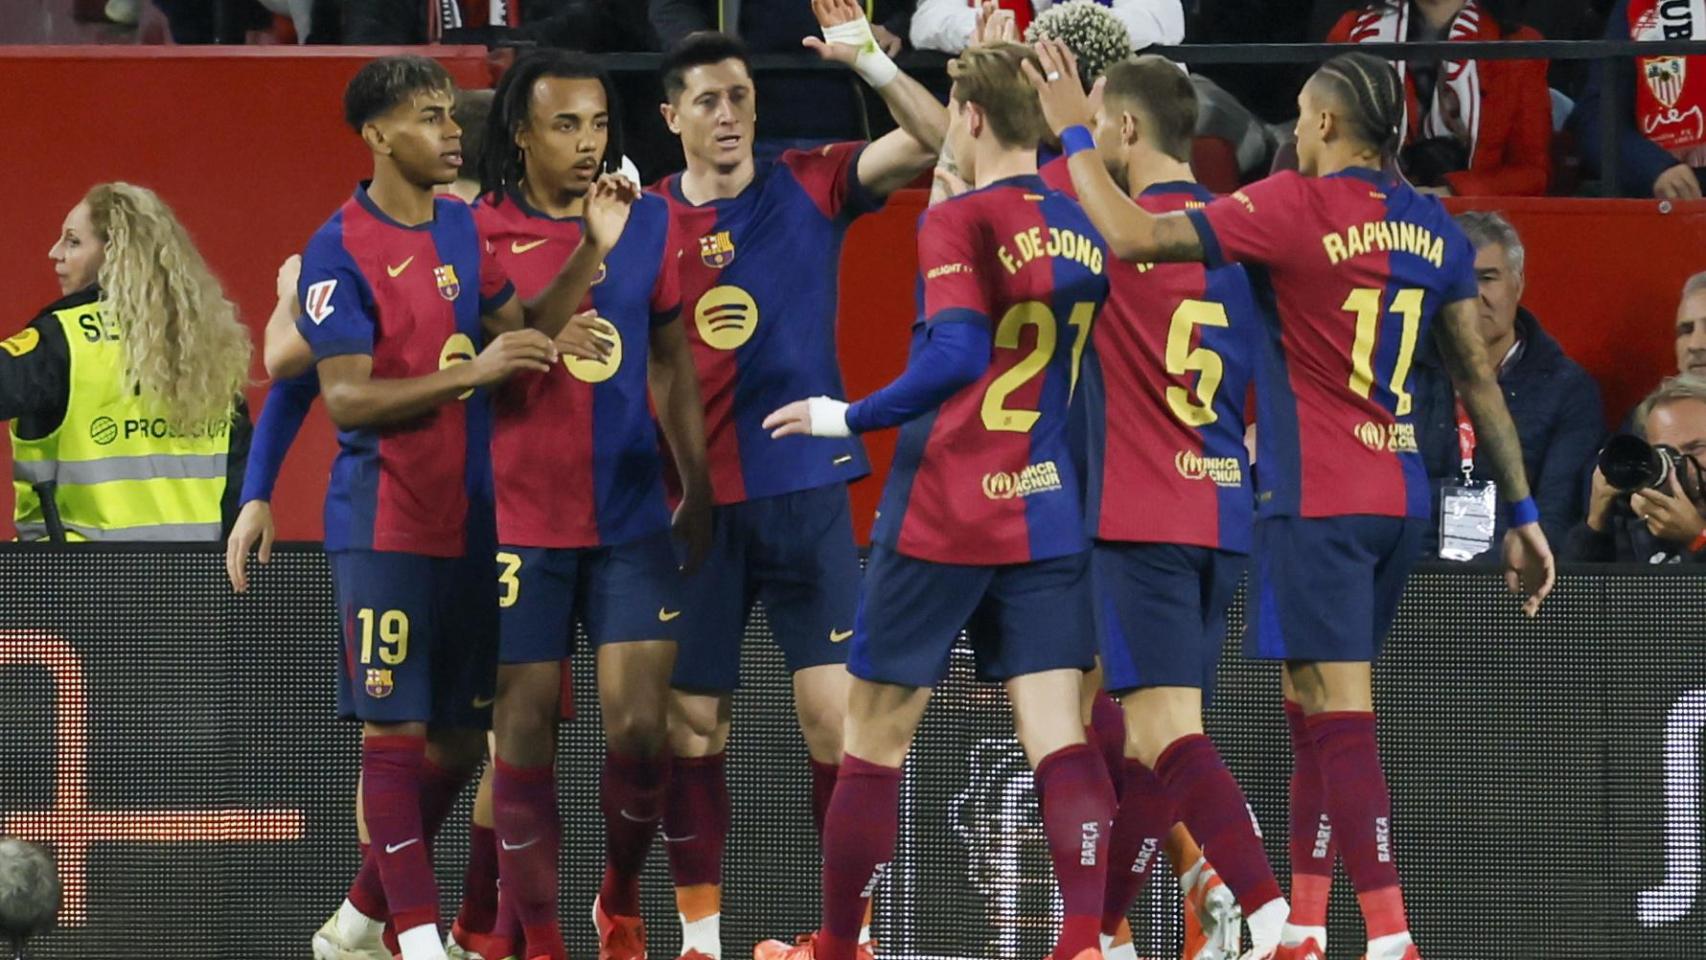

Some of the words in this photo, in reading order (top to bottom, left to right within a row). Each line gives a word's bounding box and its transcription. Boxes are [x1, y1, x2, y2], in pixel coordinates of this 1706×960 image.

[998, 245, 1023, 275] F.
[1014, 227, 1044, 262] DE
[1046, 227, 1102, 275] JONG
[1322, 220, 1444, 268] RAPHINHA
[981, 301, 1095, 432] 21
[1165, 299, 1229, 427] 5
[1341, 288, 1424, 416] 11
[496, 552, 521, 607] 3
[357, 608, 409, 665] 19
[1080, 821, 1099, 866] BARÇA
